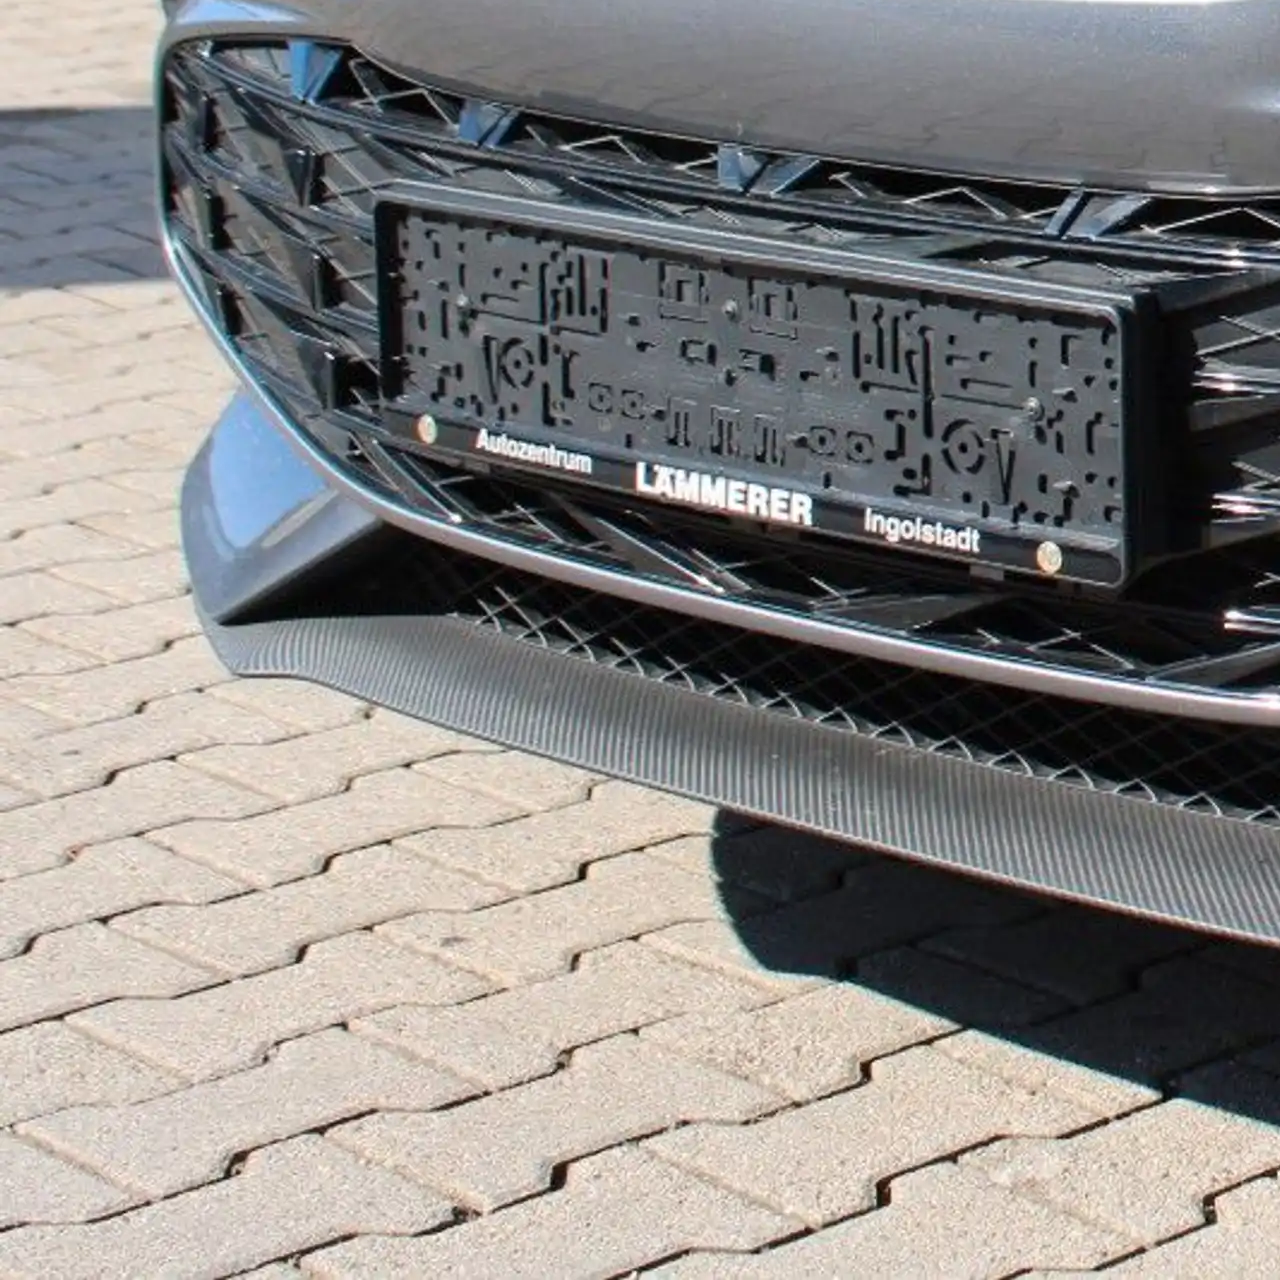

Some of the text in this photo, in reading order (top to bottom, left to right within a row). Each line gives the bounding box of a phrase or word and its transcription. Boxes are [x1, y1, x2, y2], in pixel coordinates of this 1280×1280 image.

[475, 427, 981, 553] Autozentrum LÄMMERER Ingolstadt
